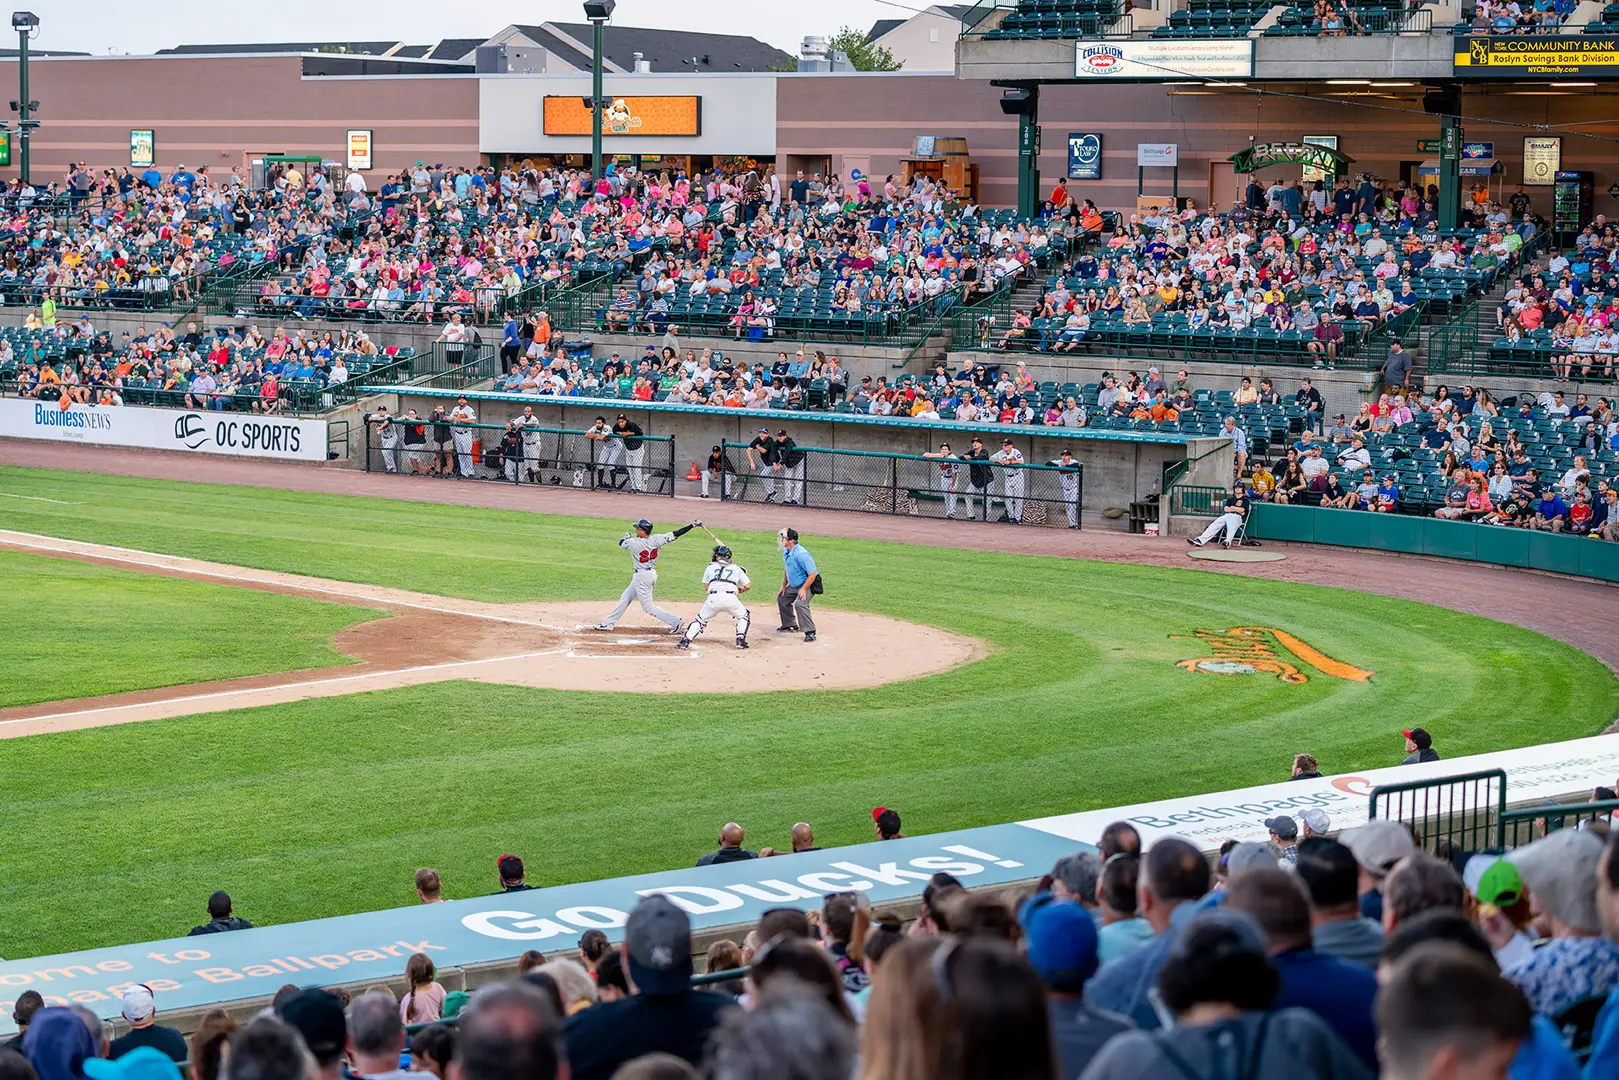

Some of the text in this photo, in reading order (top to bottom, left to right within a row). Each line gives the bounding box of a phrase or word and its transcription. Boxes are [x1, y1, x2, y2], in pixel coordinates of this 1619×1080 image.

[1082, 46, 1124, 60] COLLISION
[1507, 41, 1616, 51] COMMUNITY BANK
[1493, 54, 1615, 65] Roslyn Savings Bank Division
[1527, 66, 1580, 74] NYCBfamily.com
[1255, 142, 1315, 159] BEER
[216, 421, 301, 452] OC SPORTS
[1128, 792, 1348, 829] Bethpage
[461, 844, 1025, 941] Go Ducks!
[146, 949, 212, 965] to
[192, 939, 448, 985] Ballpark
